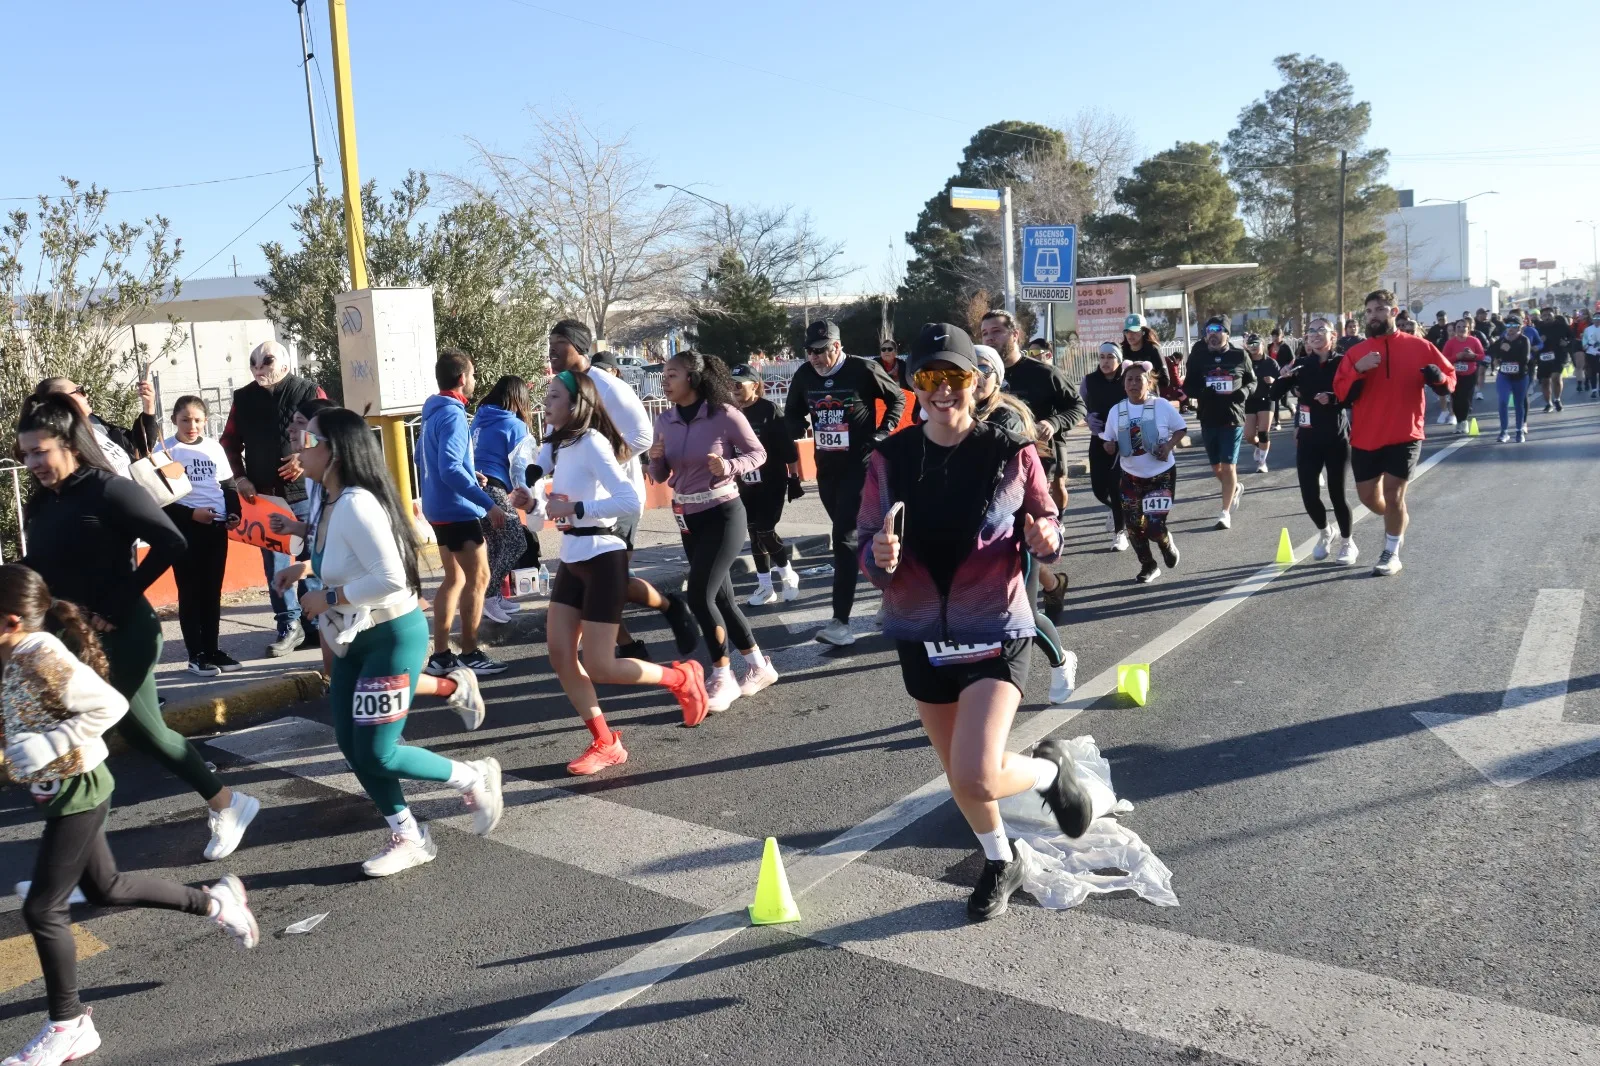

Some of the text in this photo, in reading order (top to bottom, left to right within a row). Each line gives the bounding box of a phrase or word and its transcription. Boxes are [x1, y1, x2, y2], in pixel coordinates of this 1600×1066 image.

[1034, 229, 1065, 238] ASCENSO
[1029, 237, 1069, 246] Y DESCENSO
[1024, 288, 1069, 299] TRANSBORDE
[1077, 288, 1114, 297] Los que
[1077, 298, 1107, 307] saben
[1077, 306, 1126, 316] dicen que:
[816, 409, 844, 418] WE RUN
[828, 416, 843, 425] ONE
[819, 433, 842, 446] 884
[1144, 498, 1170, 510] 1417
[355, 691, 402, 716] 2081
